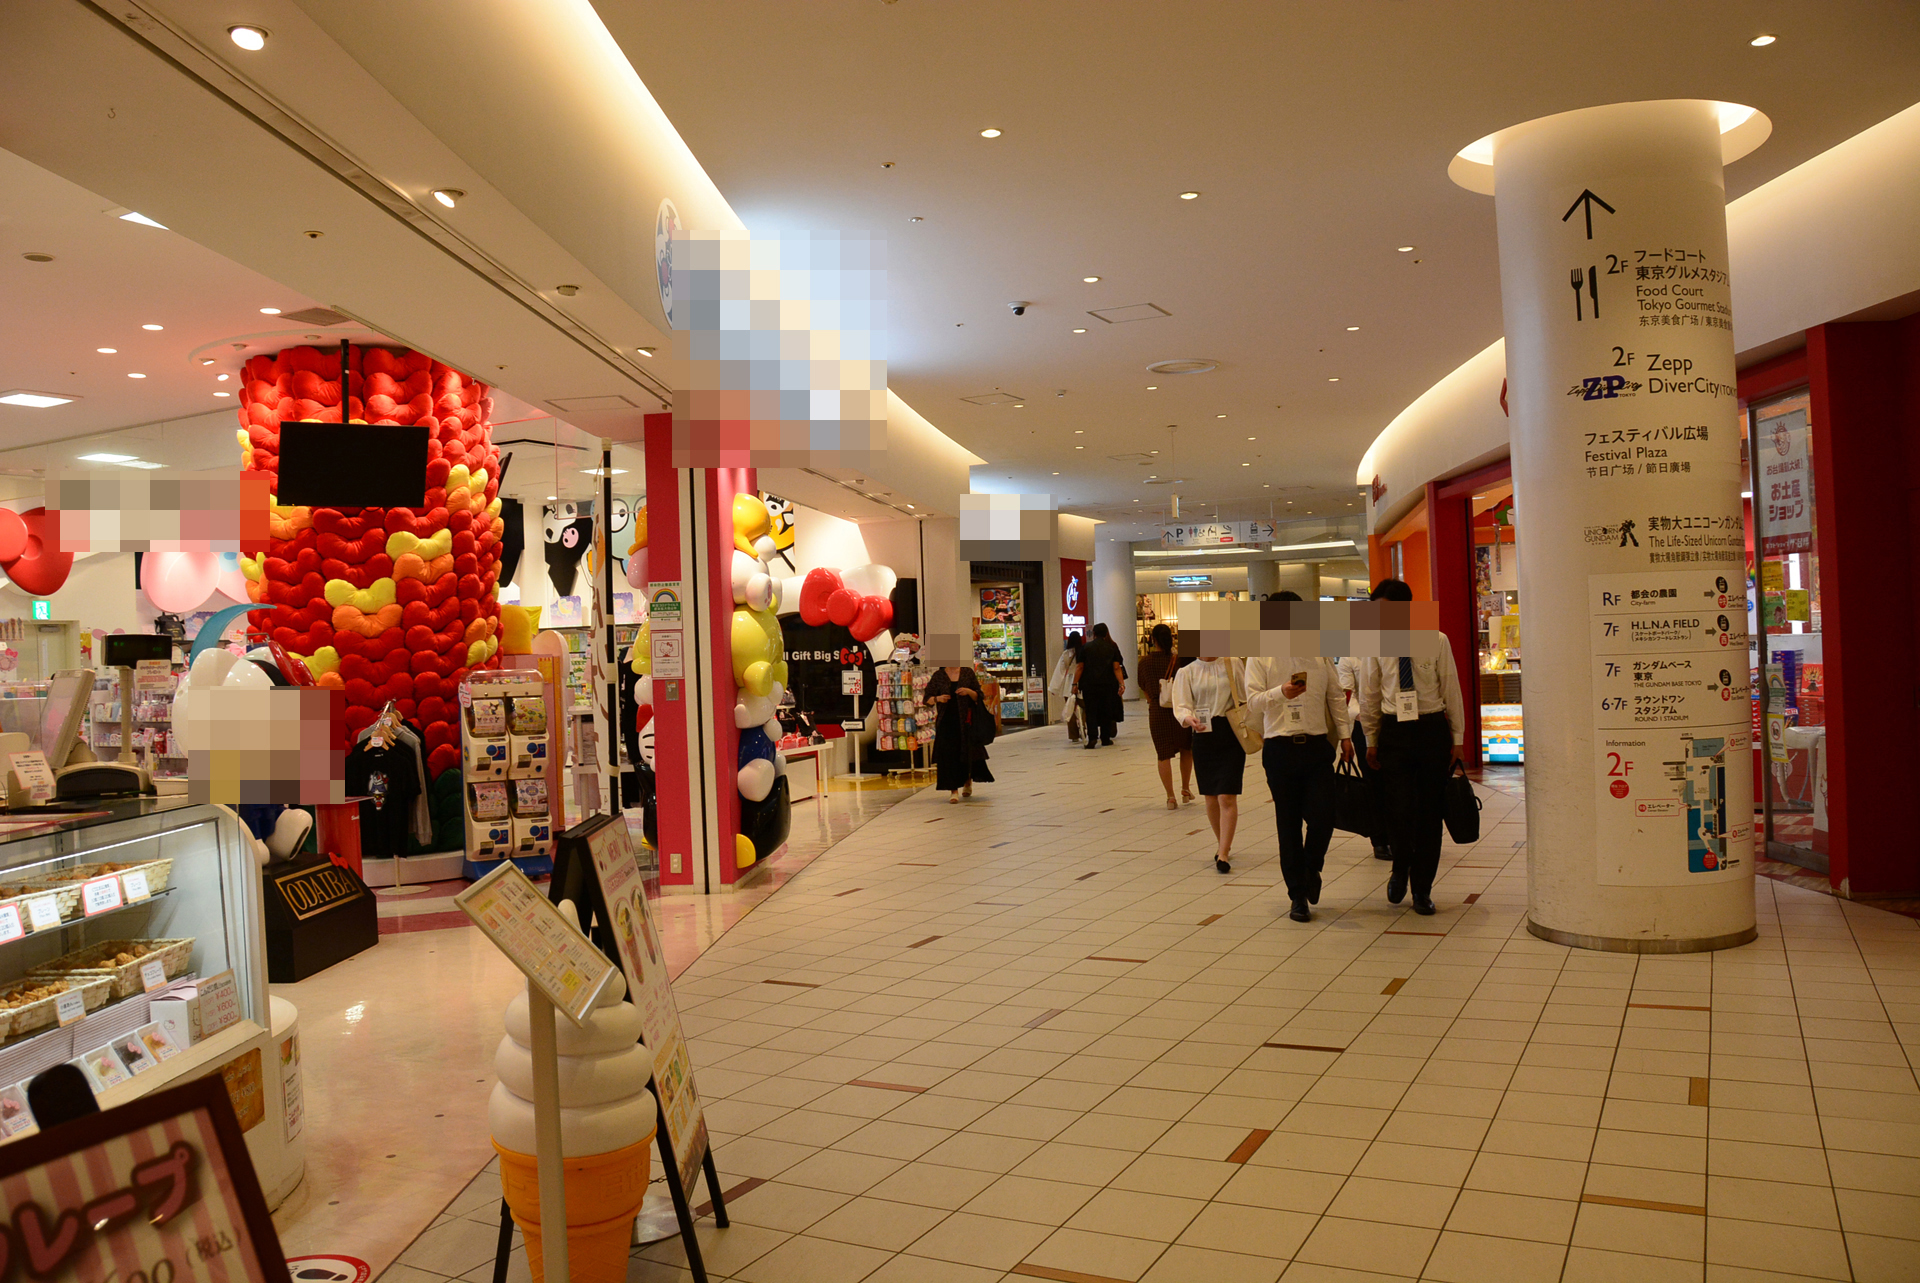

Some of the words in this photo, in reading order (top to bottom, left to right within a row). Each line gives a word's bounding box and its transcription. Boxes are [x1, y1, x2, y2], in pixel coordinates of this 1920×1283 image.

[1634, 247, 1706, 263] フードコート
[1605, 253, 1628, 274] 2F
[1636, 284, 1668, 297] Food
[1672, 283, 1704, 297] Court
[1637, 298, 1672, 313] Tokyo
[1675, 298, 1715, 312] Gourmet
[1612, 346, 1635, 366] 2F
[1646, 354, 1693, 375] Zepp
[1584, 426, 1709, 446] フェスティバル広場
[1585, 447, 1631, 462] Festival
[1636, 446, 1668, 459] Plaza
[1771, 479, 1801, 501] お土産
[1769, 499, 1804, 522] ショップ
[1649, 535, 1665, 548] The
[1667, 534, 1702, 547] Life-Sized
[1603, 592, 1621, 606] RF
[1631, 589, 1677, 599] 都会の農園
[1603, 622, 1619, 636] 7F
[1631, 620, 1671, 630] H.L.N.A
[1673, 619, 1700, 629] FIELD
[792, 651, 811, 660] Gift
[814, 651, 831, 662] Big
[1605, 663, 1621, 677] 7F
[1633, 660, 1692, 671] ガンダムベース
[1634, 672, 1653, 681] 東京
[1634, 695, 1685, 705] ラウンドワン
[1634, 706, 1677, 716] スタジアム
[1607, 752, 1634, 776] 2F
[286, 867, 357, 911] ODAIBA
